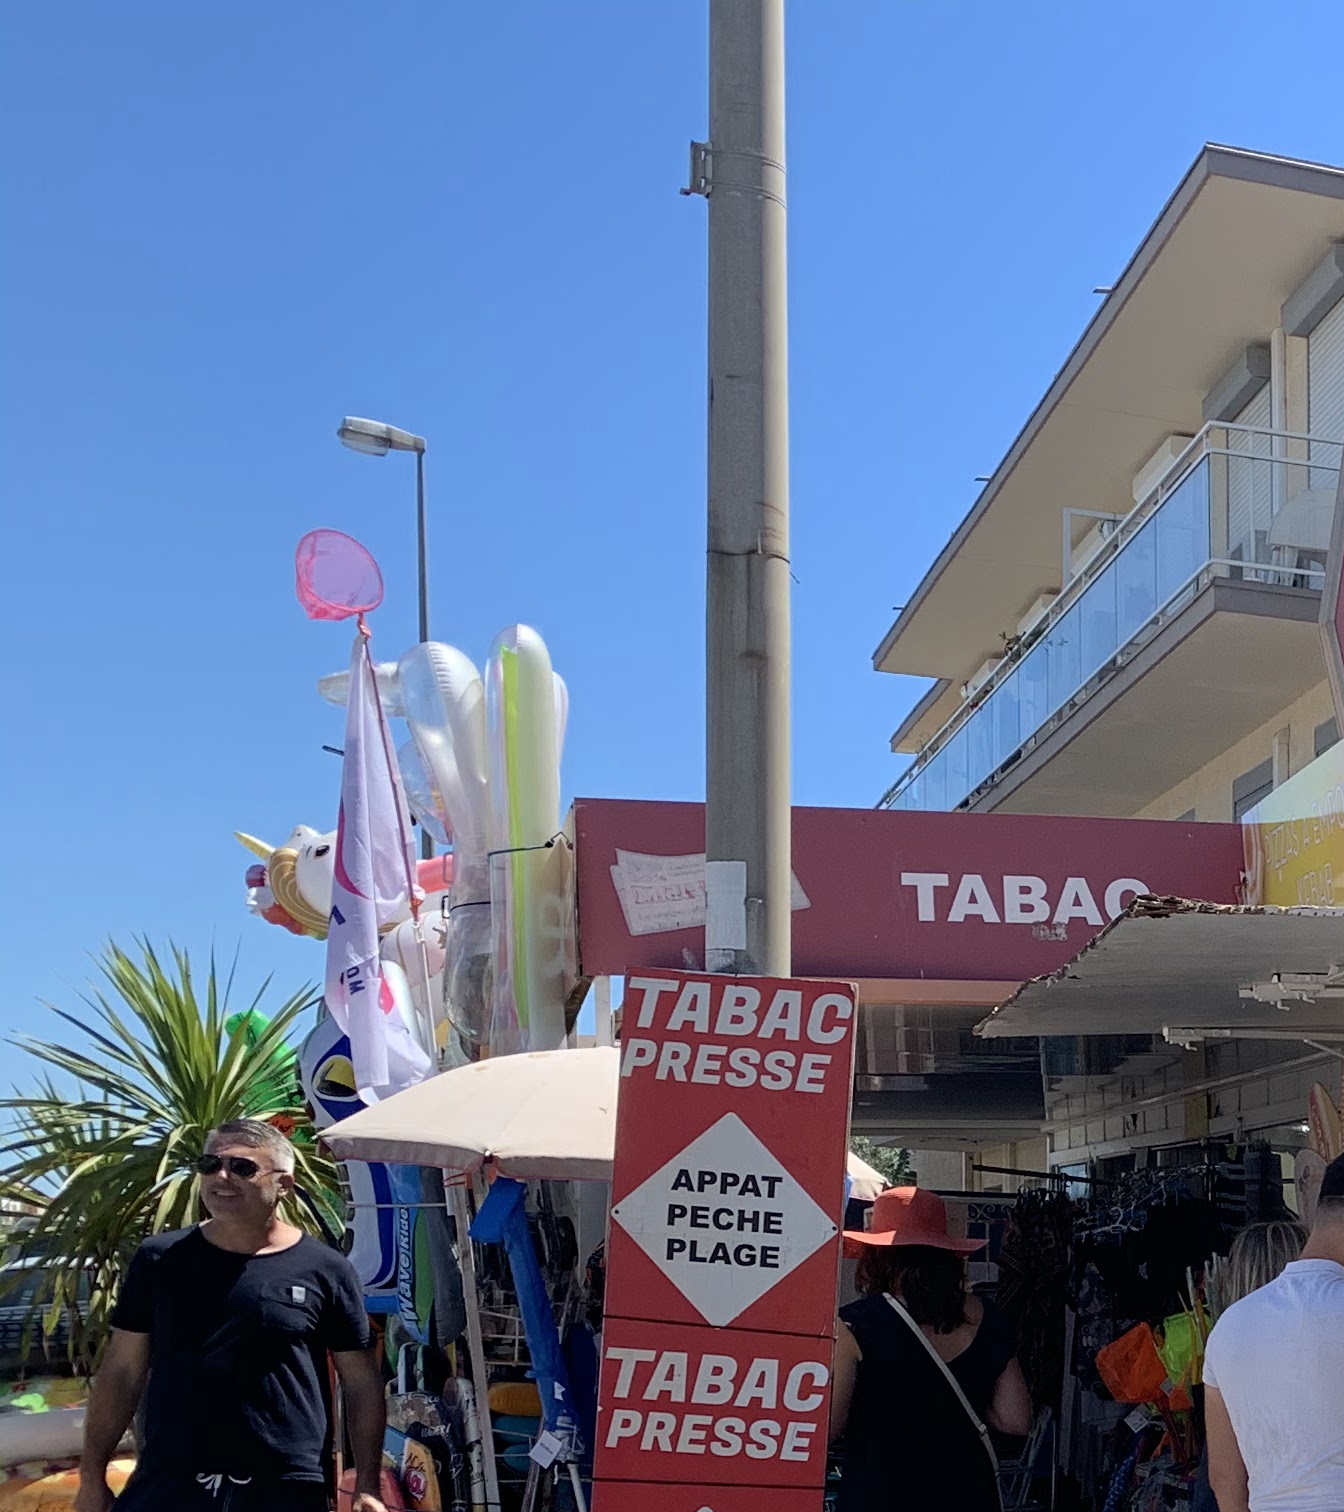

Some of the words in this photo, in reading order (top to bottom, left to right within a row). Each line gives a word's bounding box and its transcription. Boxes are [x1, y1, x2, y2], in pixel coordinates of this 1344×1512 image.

[628, 976, 853, 1045] TABAC
[619, 1037, 832, 1094] PRESSE
[670, 1168, 783, 1199] APPAT
[666, 1203, 783, 1235] PECHE
[399, 1203, 419, 1321] WaveRide
[665, 1237, 780, 1269] PLAGE
[605, 1346, 829, 1413] TABAC
[604, 1408, 816, 1462] PRESSE
